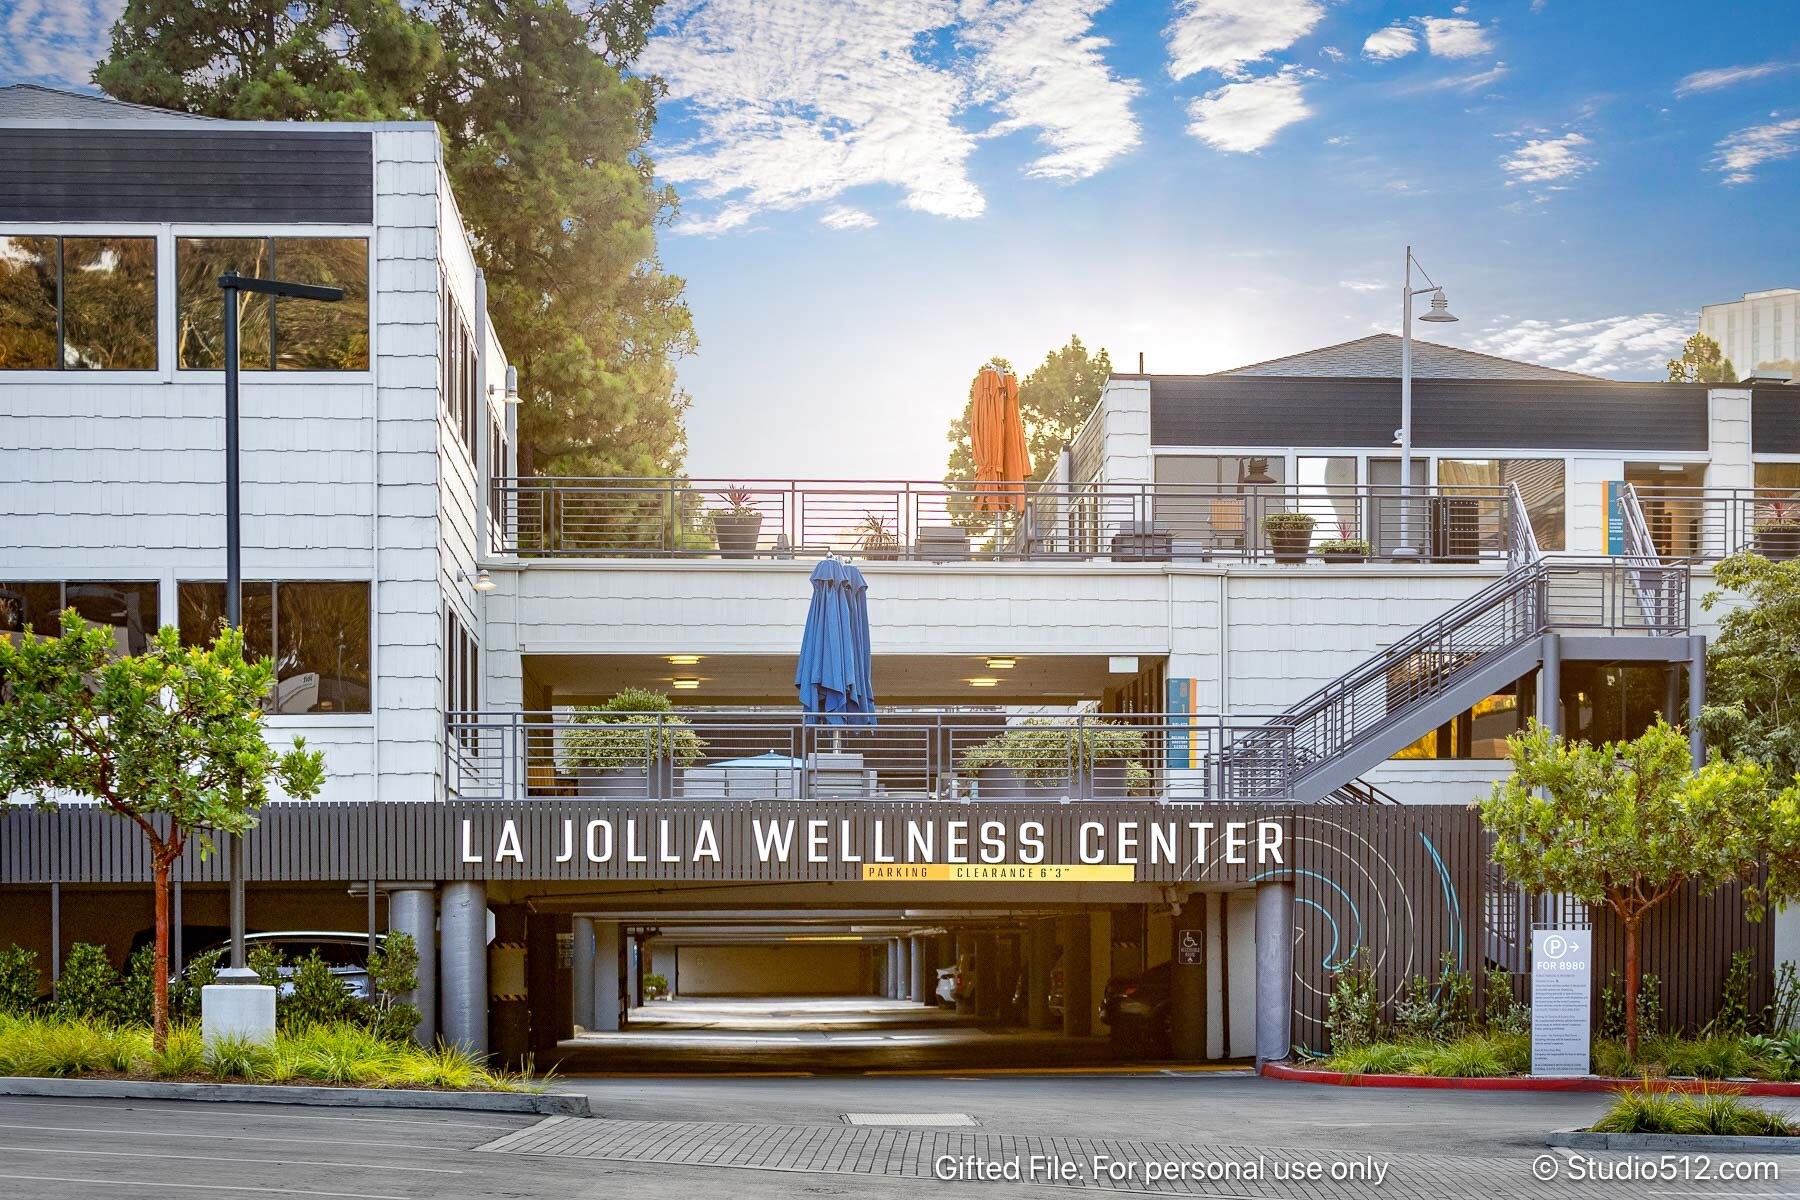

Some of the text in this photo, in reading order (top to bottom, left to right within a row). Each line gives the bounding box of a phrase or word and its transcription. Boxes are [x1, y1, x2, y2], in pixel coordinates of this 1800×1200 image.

[462, 819, 1285, 865] LA JOLLA WELLNESS CENTER
[868, 867, 928, 878] PARKING
[957, 867, 1034, 878] CLEARANCE
[1537, 961, 1586, 971] FOR 8980
